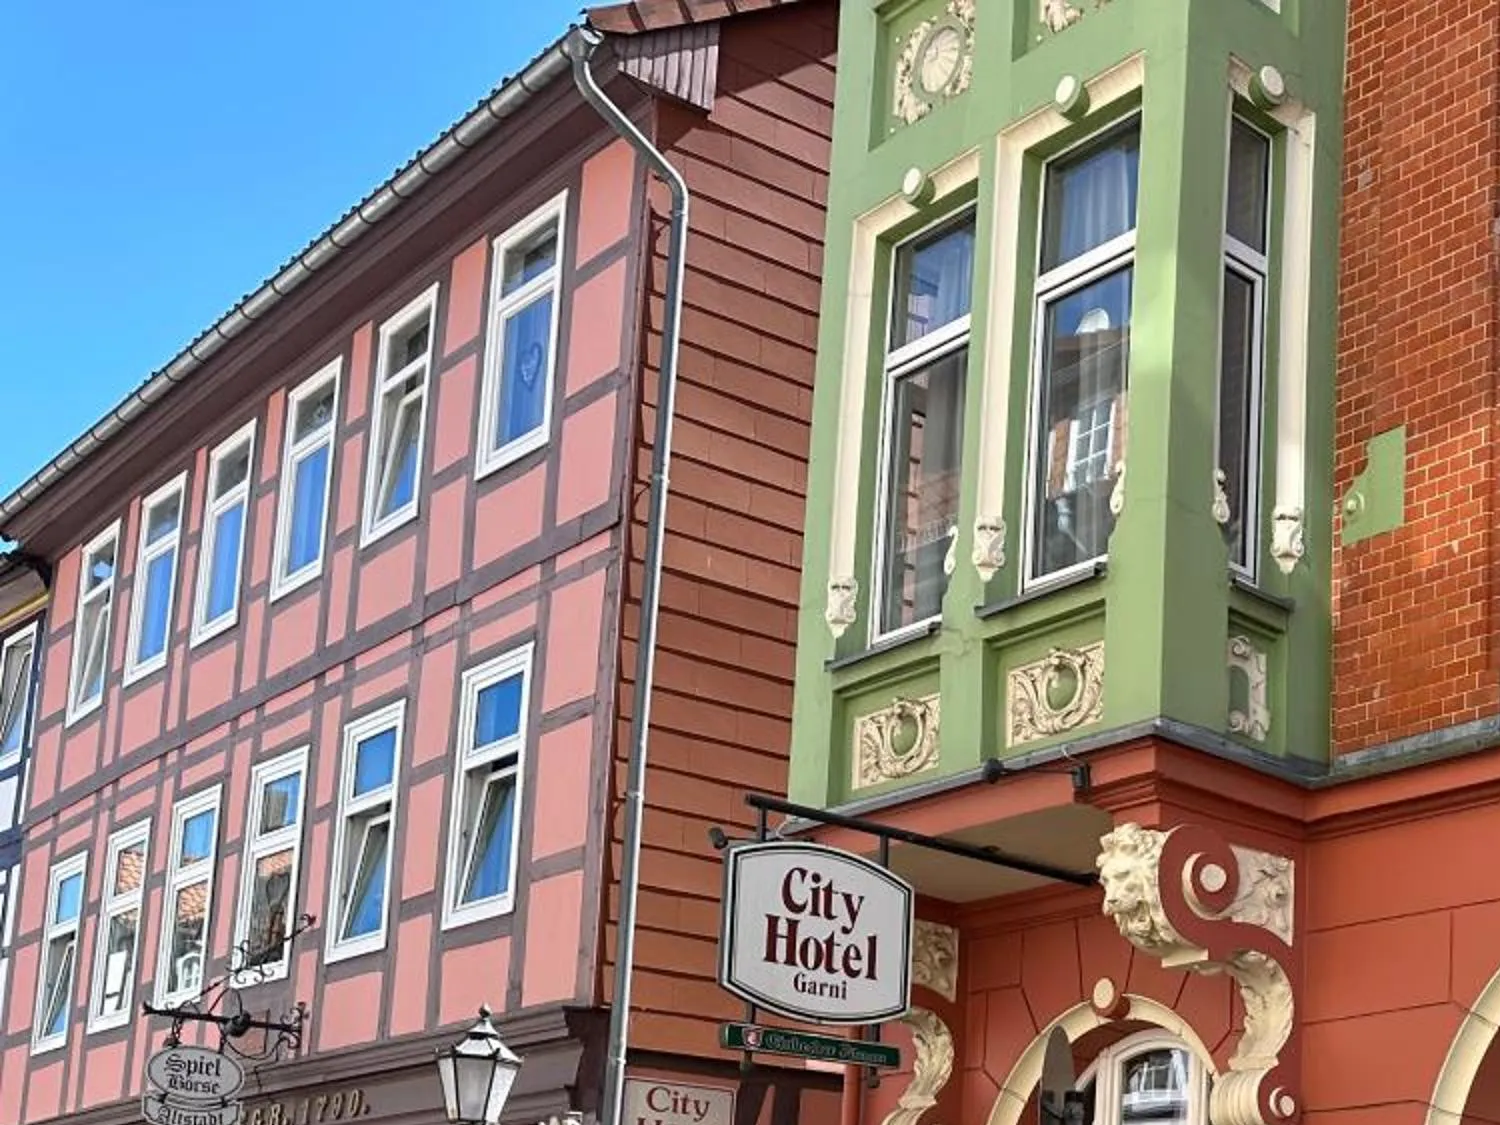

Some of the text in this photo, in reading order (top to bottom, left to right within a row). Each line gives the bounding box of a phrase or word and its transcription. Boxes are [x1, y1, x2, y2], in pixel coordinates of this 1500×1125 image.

[782, 867, 865, 934] City
[763, 914, 877, 980] Hotel
[793, 973, 847, 1000] Garni
[164, 1053, 221, 1077] Spiel
[157, 1103, 223, 1125] Altstadt
[645, 1086, 711, 1122] City
